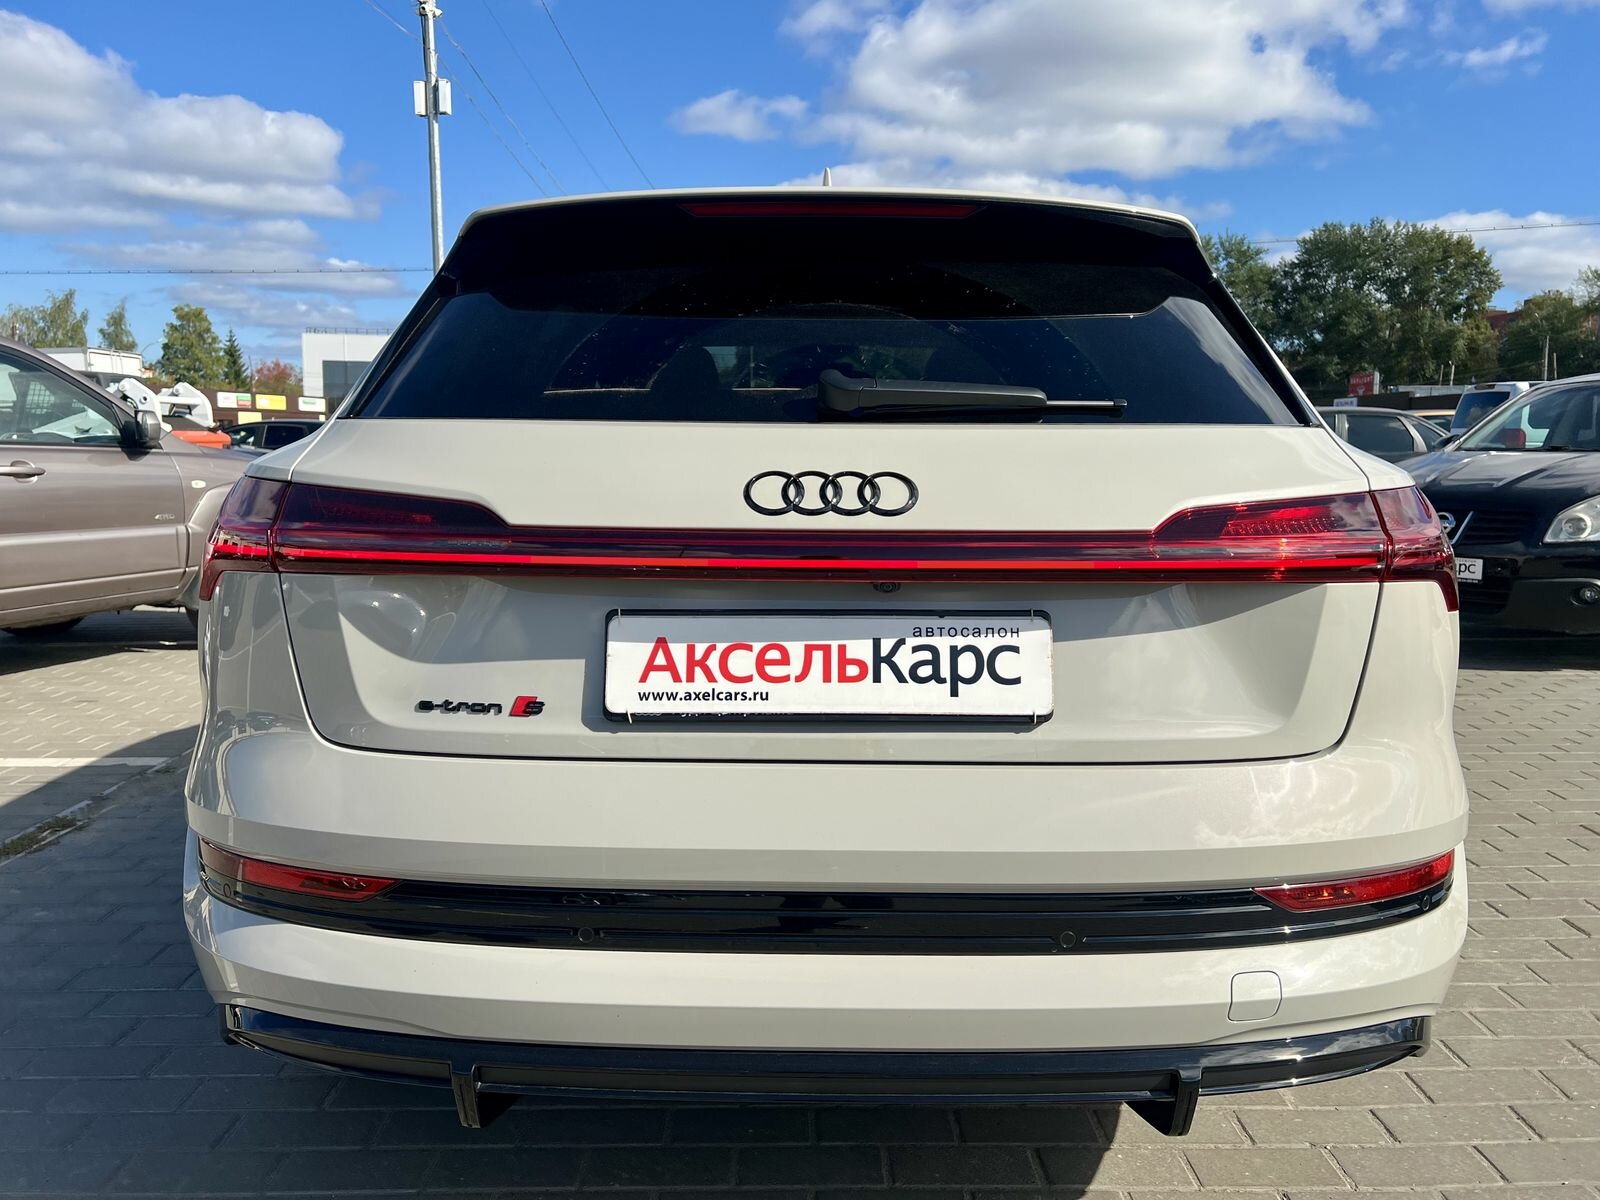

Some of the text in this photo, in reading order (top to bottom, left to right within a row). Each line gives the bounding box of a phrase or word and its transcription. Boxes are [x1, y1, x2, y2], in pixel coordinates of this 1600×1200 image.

[912, 626, 1020, 638] автосалон
[638, 636, 1022, 698] АксельКарс
[637, 687, 769, 702] www.axelcars.ru
[417, 699, 503, 715] e-tron
